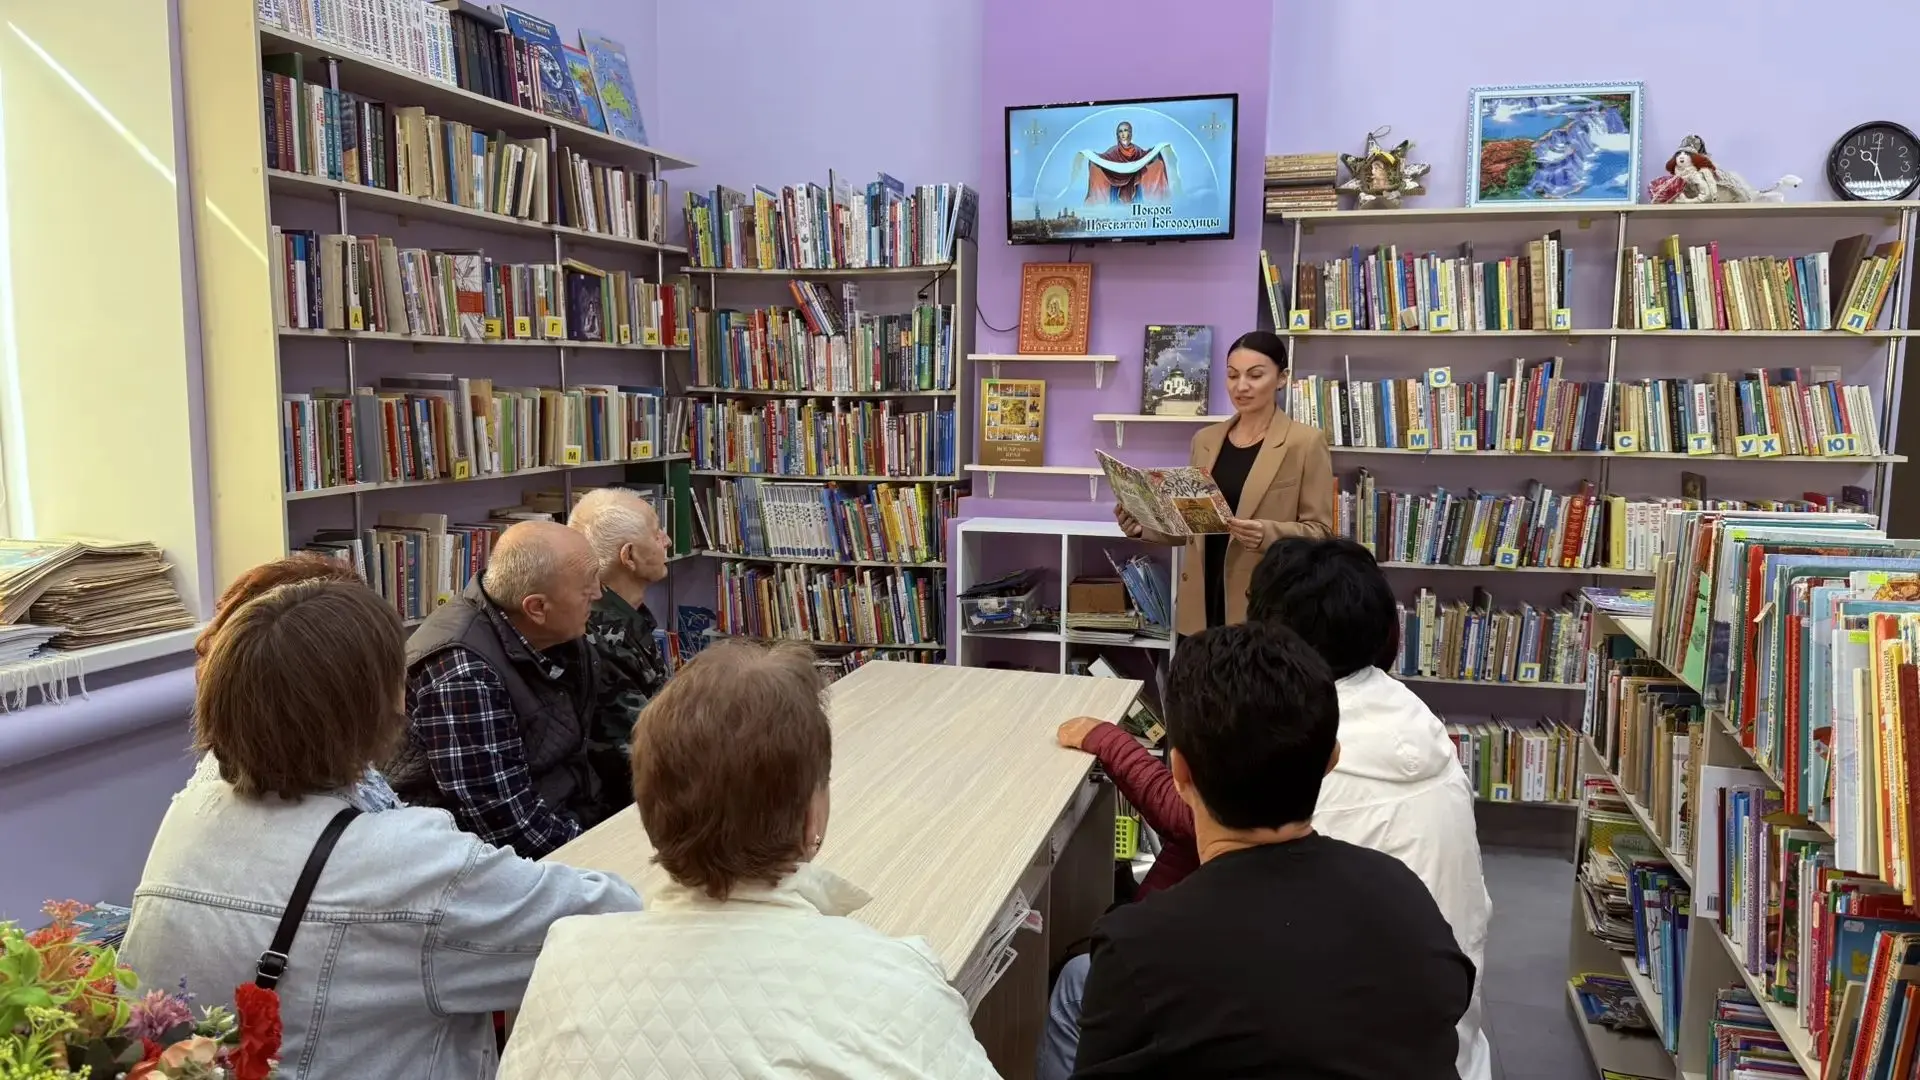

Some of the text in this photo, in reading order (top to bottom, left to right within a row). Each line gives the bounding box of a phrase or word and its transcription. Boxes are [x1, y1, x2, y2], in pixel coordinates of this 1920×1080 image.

[1132, 204, 1172, 218] Покров
[1087, 217, 1220, 232] Пресвятой Богородицы
